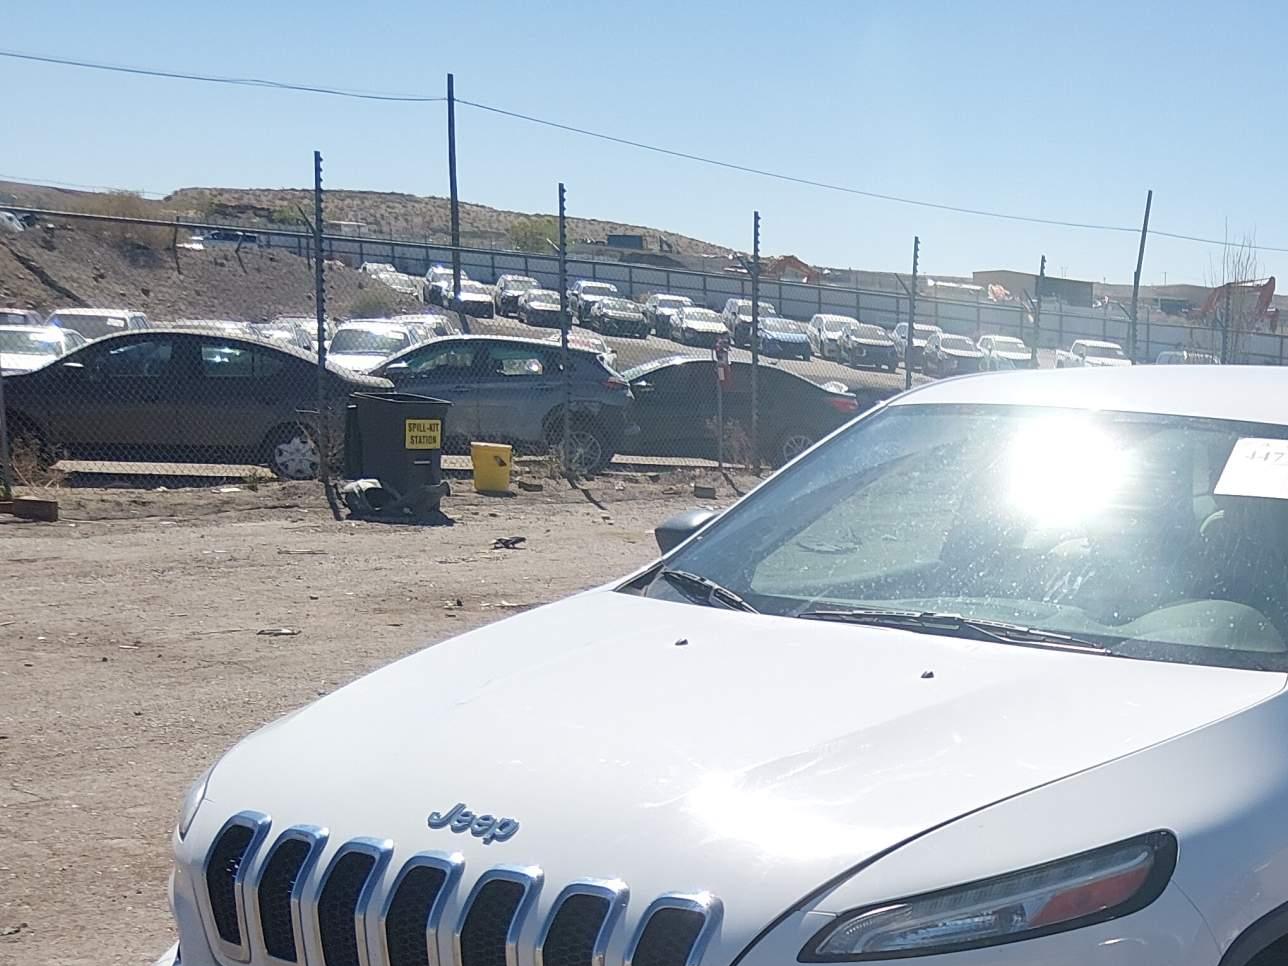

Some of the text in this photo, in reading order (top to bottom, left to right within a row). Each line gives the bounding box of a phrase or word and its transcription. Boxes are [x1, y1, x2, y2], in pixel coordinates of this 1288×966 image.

[407, 422, 440, 433] SPILL-KIT
[410, 435, 437, 445] STATION
[427, 802, 520, 846] Jeep
